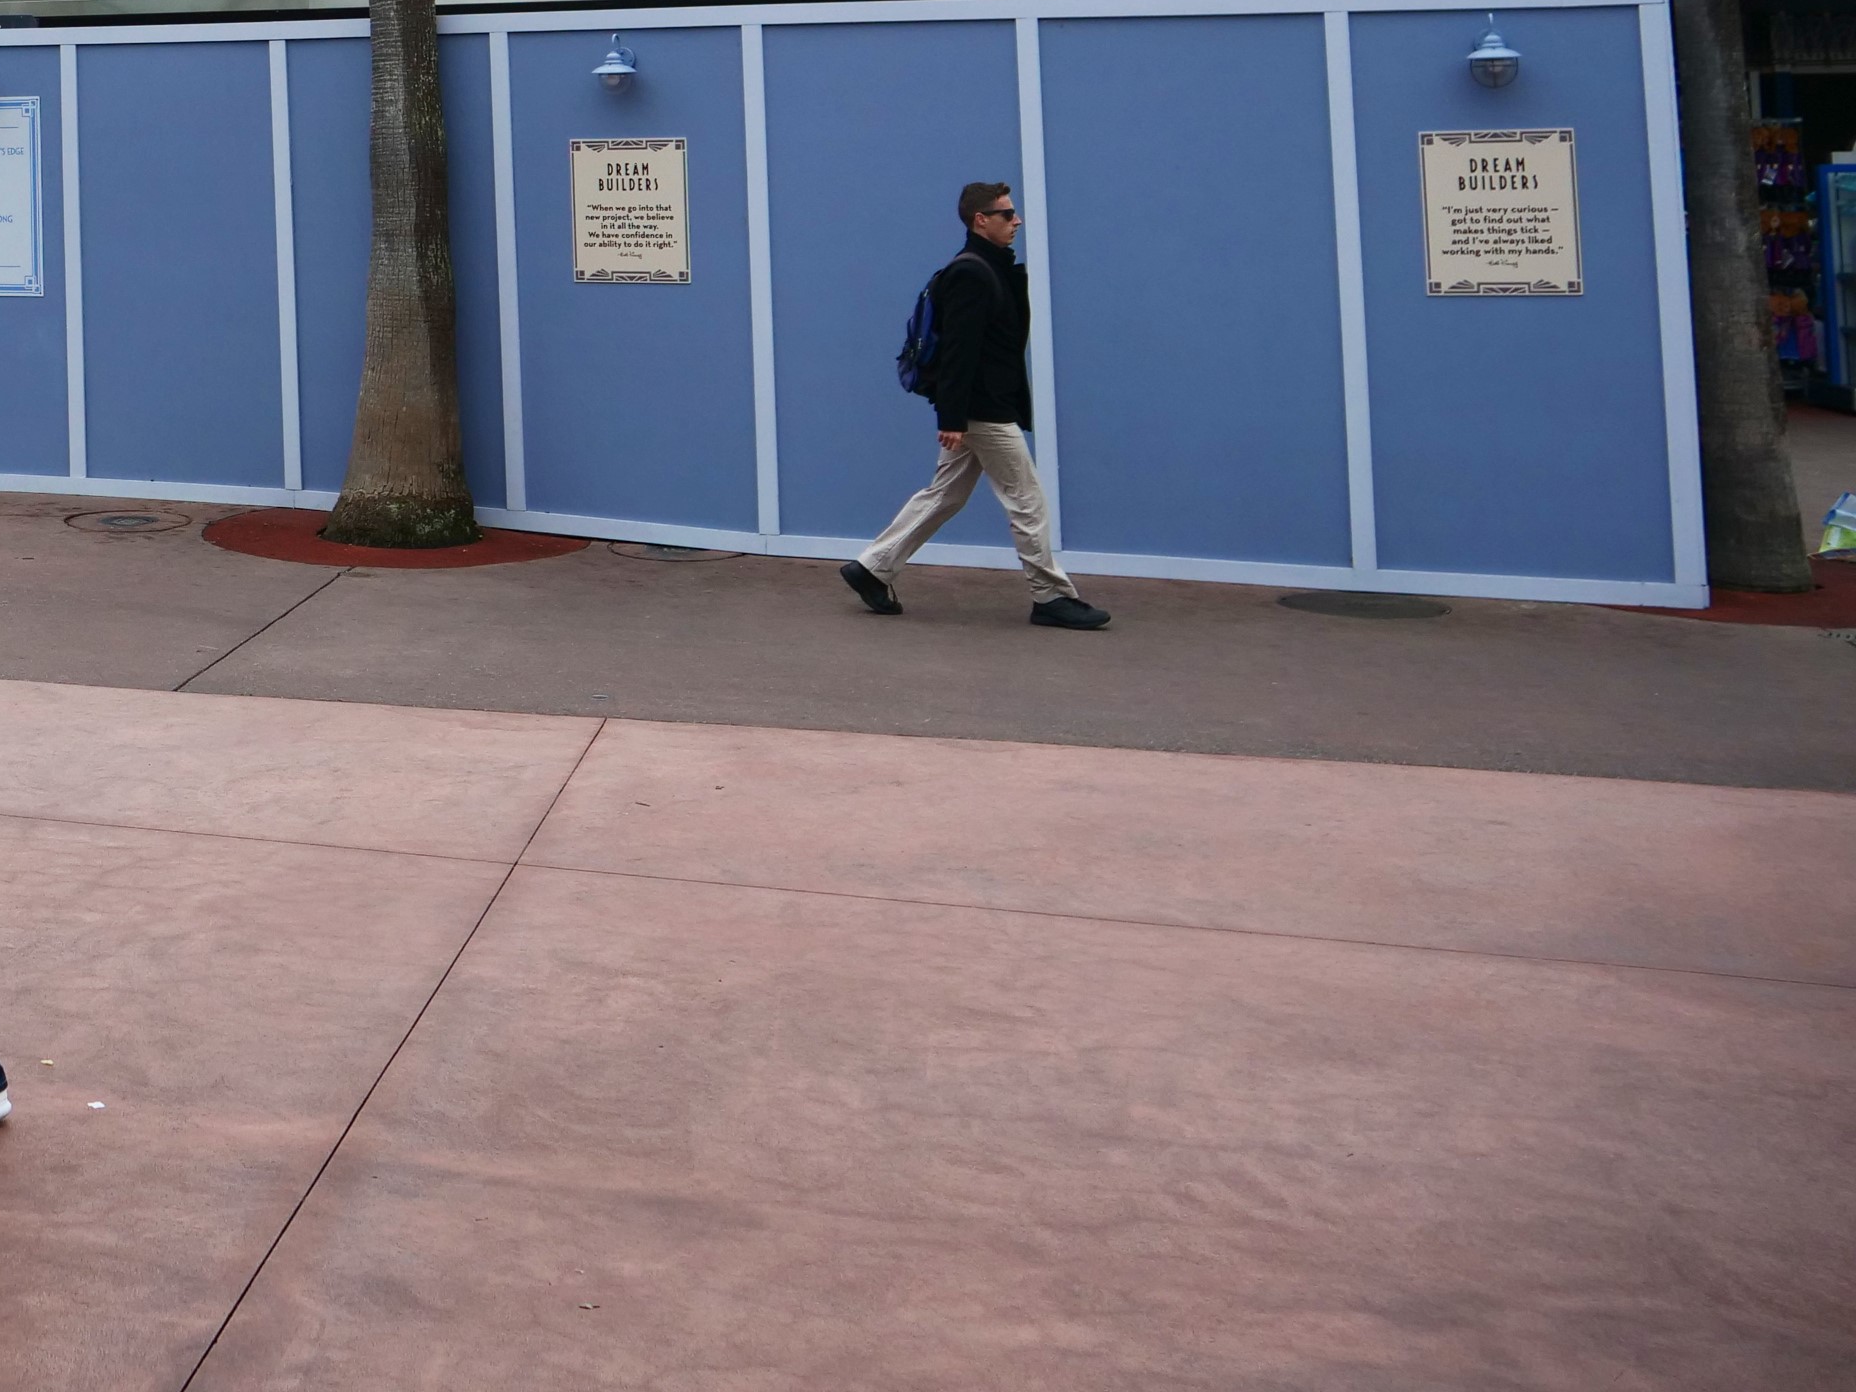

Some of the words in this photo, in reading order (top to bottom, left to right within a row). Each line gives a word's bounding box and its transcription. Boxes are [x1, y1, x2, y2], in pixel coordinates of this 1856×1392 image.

[7, 147, 24, 155] EDGE
[608, 163, 649, 176] DREAM
[1469, 157, 1525, 173] DREAM
[599, 178, 658, 191] BUILDERS
[1458, 175, 1538, 191] BUILDERS
[1465, 206, 1483, 215] just
[1451, 217, 1467, 226] got
[1487, 226, 1517, 236] things
[599, 240, 621, 249] ability
[1452, 237, 1469, 245] and
[1493, 237, 1525, 246] always
[1528, 236, 1552, 244] liked
[1442, 247, 1481, 256] working
[1508, 248, 1522, 256] my
